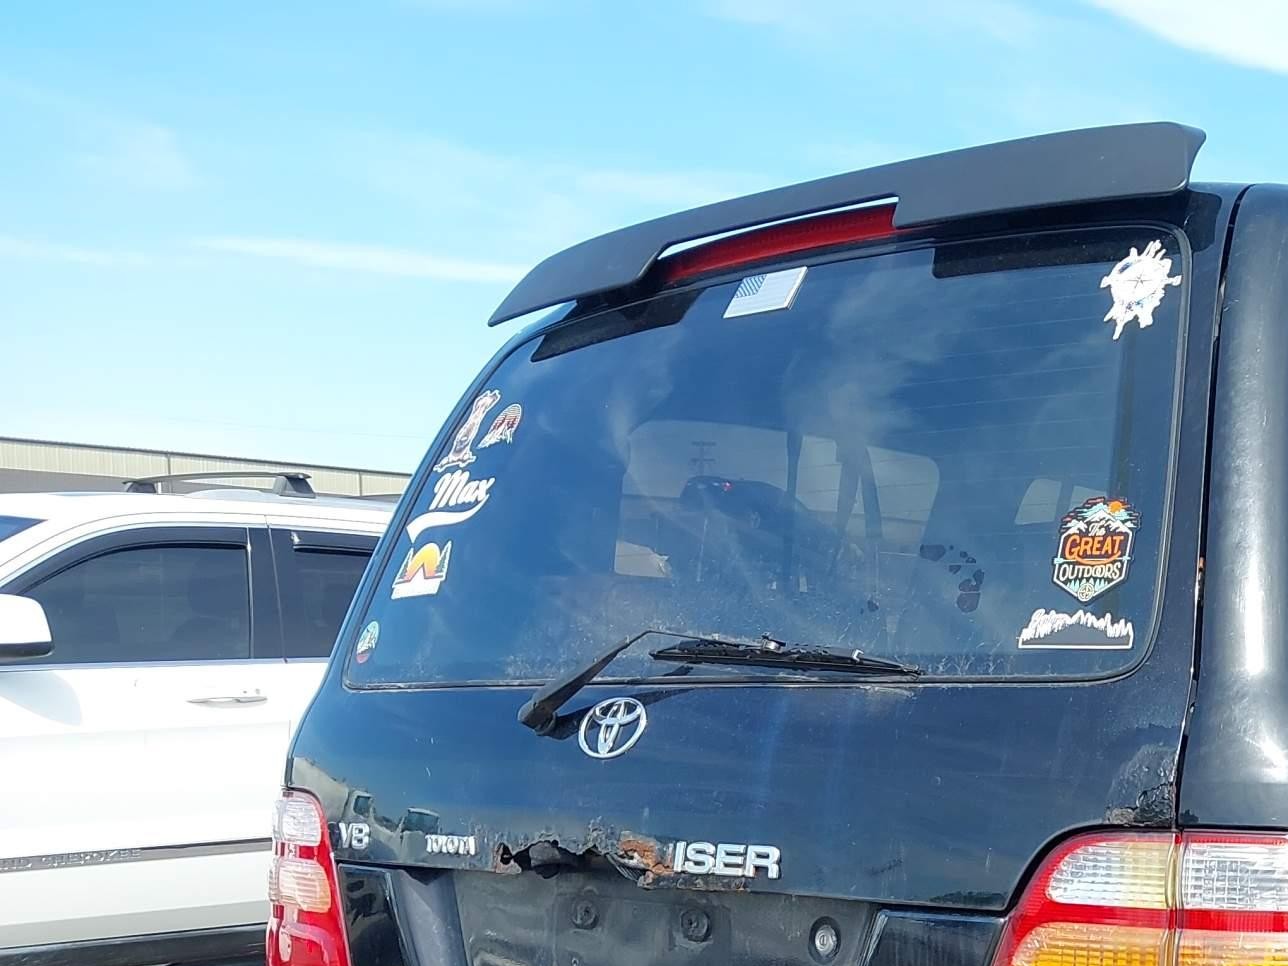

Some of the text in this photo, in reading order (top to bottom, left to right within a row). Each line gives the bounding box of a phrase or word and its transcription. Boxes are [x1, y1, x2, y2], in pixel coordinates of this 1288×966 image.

[428, 469, 495, 511] Max
[1088, 521, 1106, 537] The
[1065, 534, 1124, 561] GREAT
[1059, 562, 1121, 581] OUTDOORS
[338, 821, 370, 850] V8
[424, 833, 477, 856] TOYOTA
[673, 840, 781, 879] ISER
